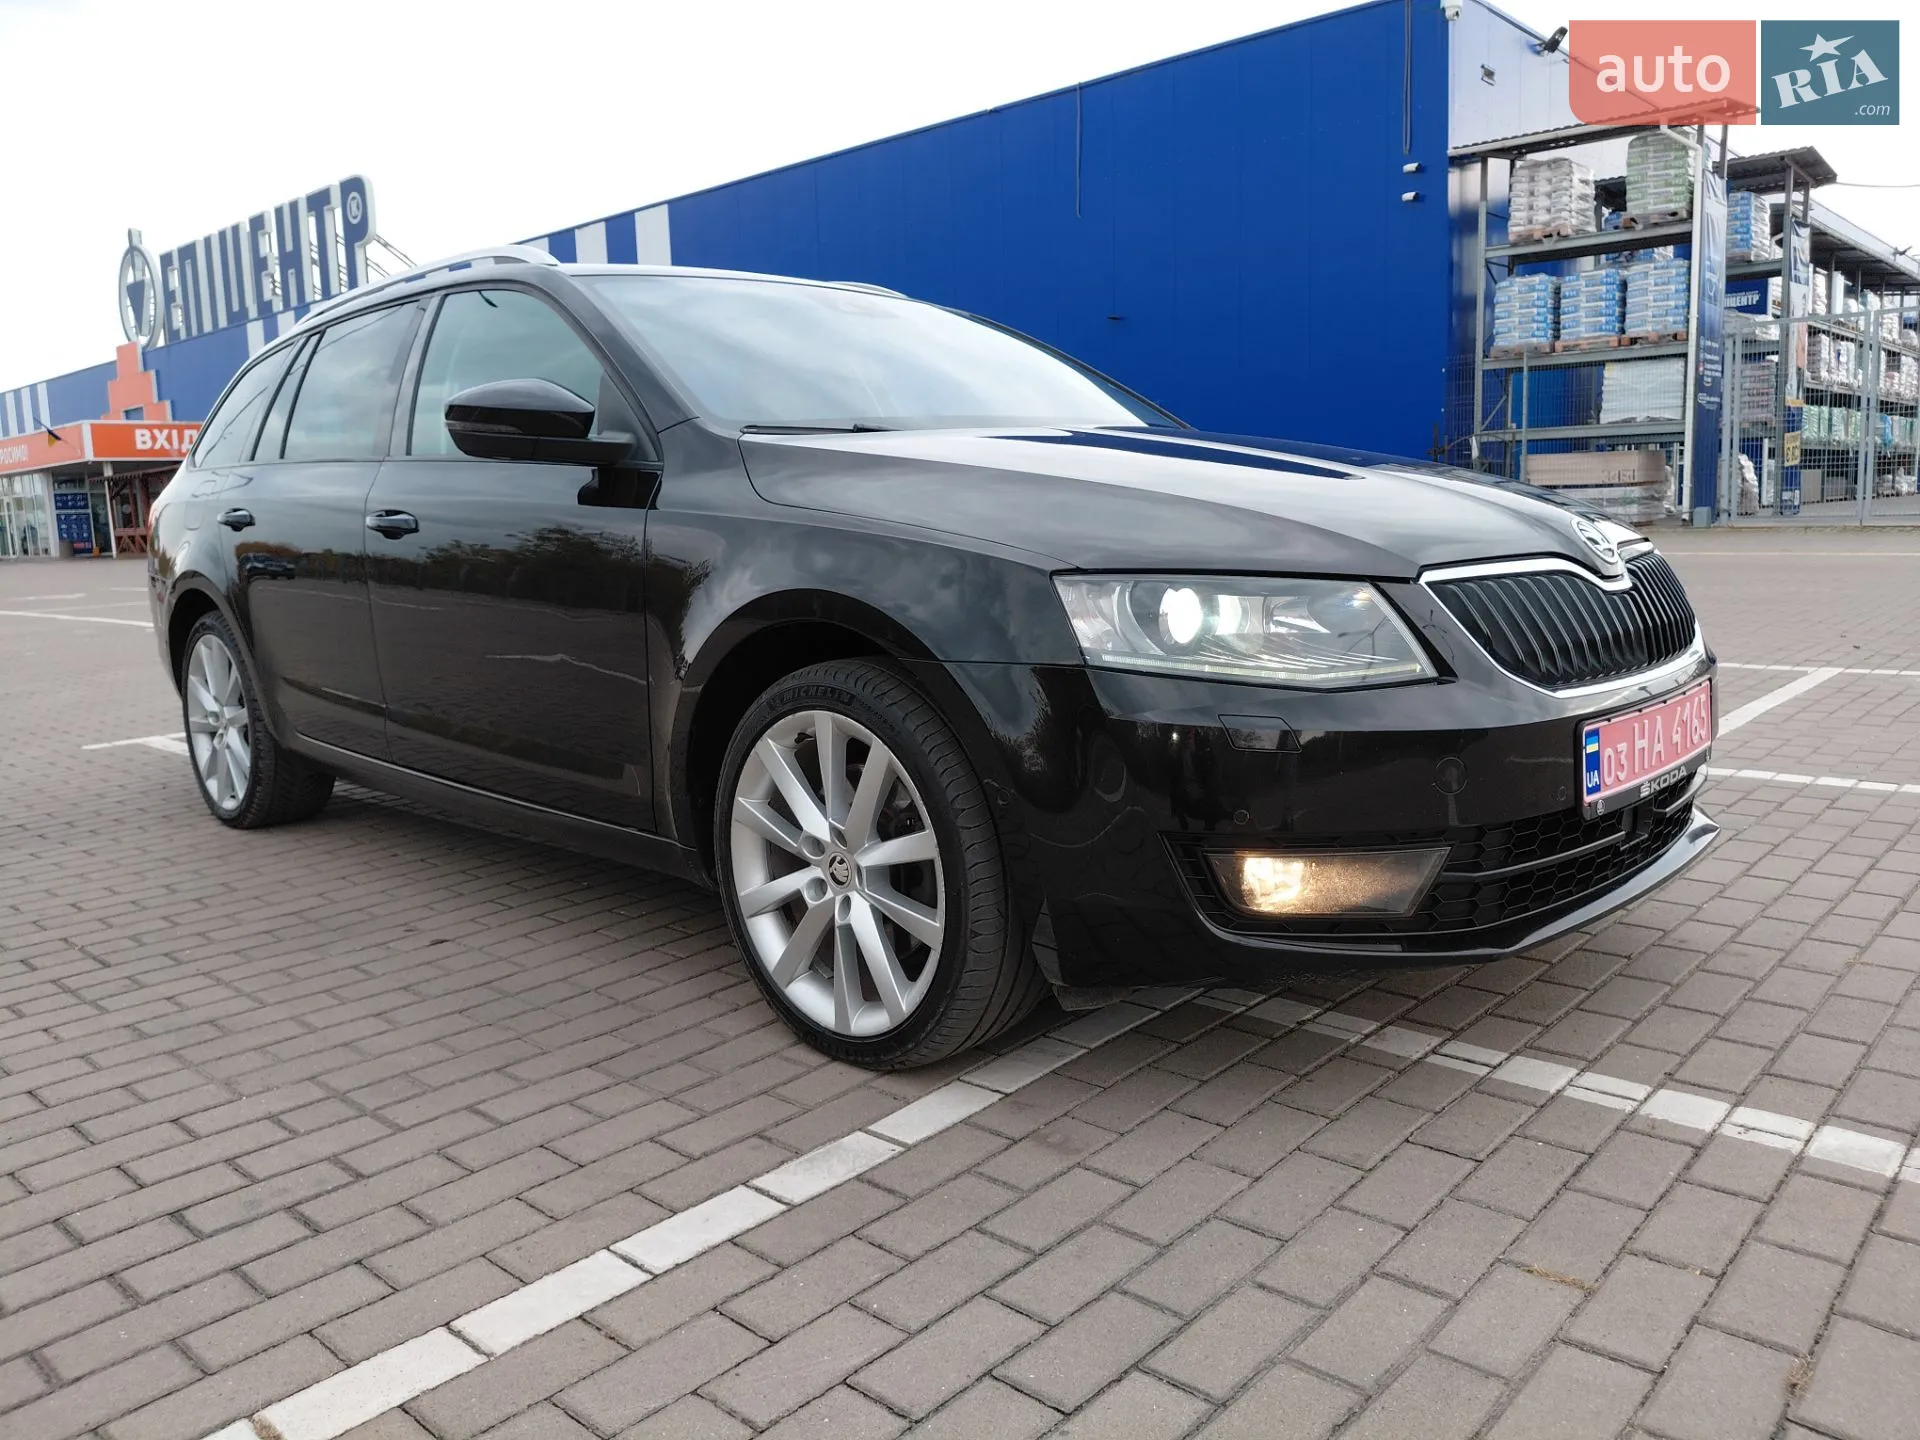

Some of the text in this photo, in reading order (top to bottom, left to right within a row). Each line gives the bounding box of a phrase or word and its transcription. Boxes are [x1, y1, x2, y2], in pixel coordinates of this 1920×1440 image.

[159, 174, 376, 344] ЕПІЦЕНТР
[135, 428, 199, 453] ВХІД
[783, 686, 852, 705] MICHELIN
[1604, 694, 1706, 786] 03 HA 4165
[1585, 769, 1600, 788] UA
[1640, 765, 1687, 798] ŠKODA
